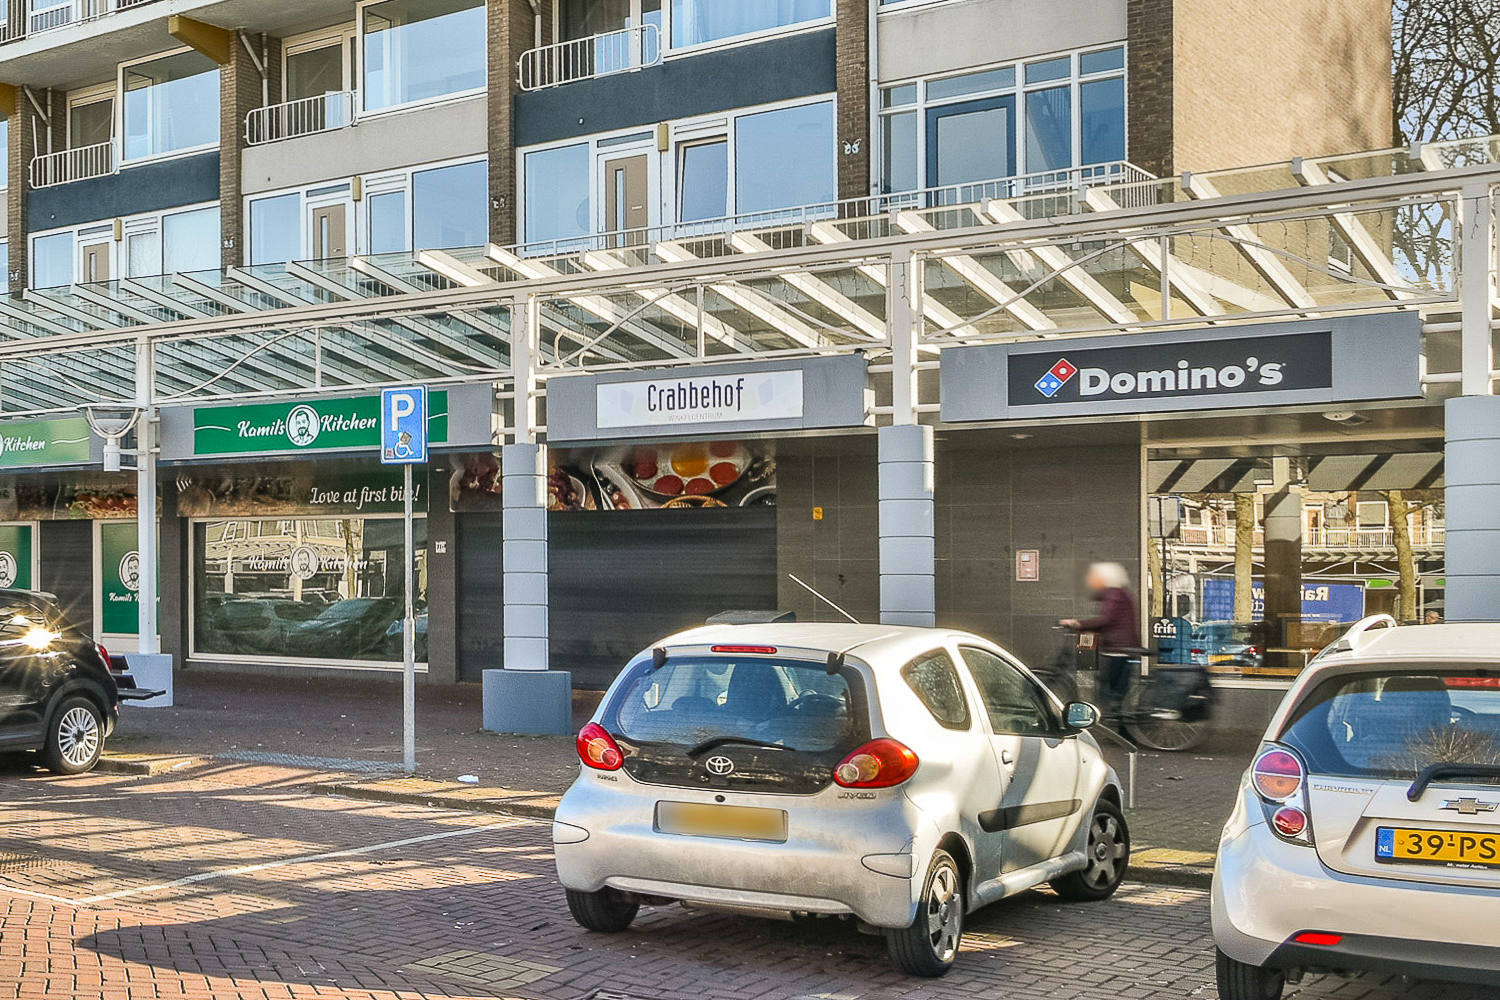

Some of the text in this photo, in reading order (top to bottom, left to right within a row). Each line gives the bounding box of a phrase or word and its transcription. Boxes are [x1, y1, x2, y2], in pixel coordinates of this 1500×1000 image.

[1079, 356, 1284, 396] Domino's
[647, 378, 745, 412] Crabbehof
[237, 412, 377, 437] Kamil's Kitchen
[391, 393, 415, 431] P
[668, 412, 723, 421] WINKELCENTRUM
[3, 436, 46, 452] Kitchen
[310, 484, 421, 510] Love at first bi!
